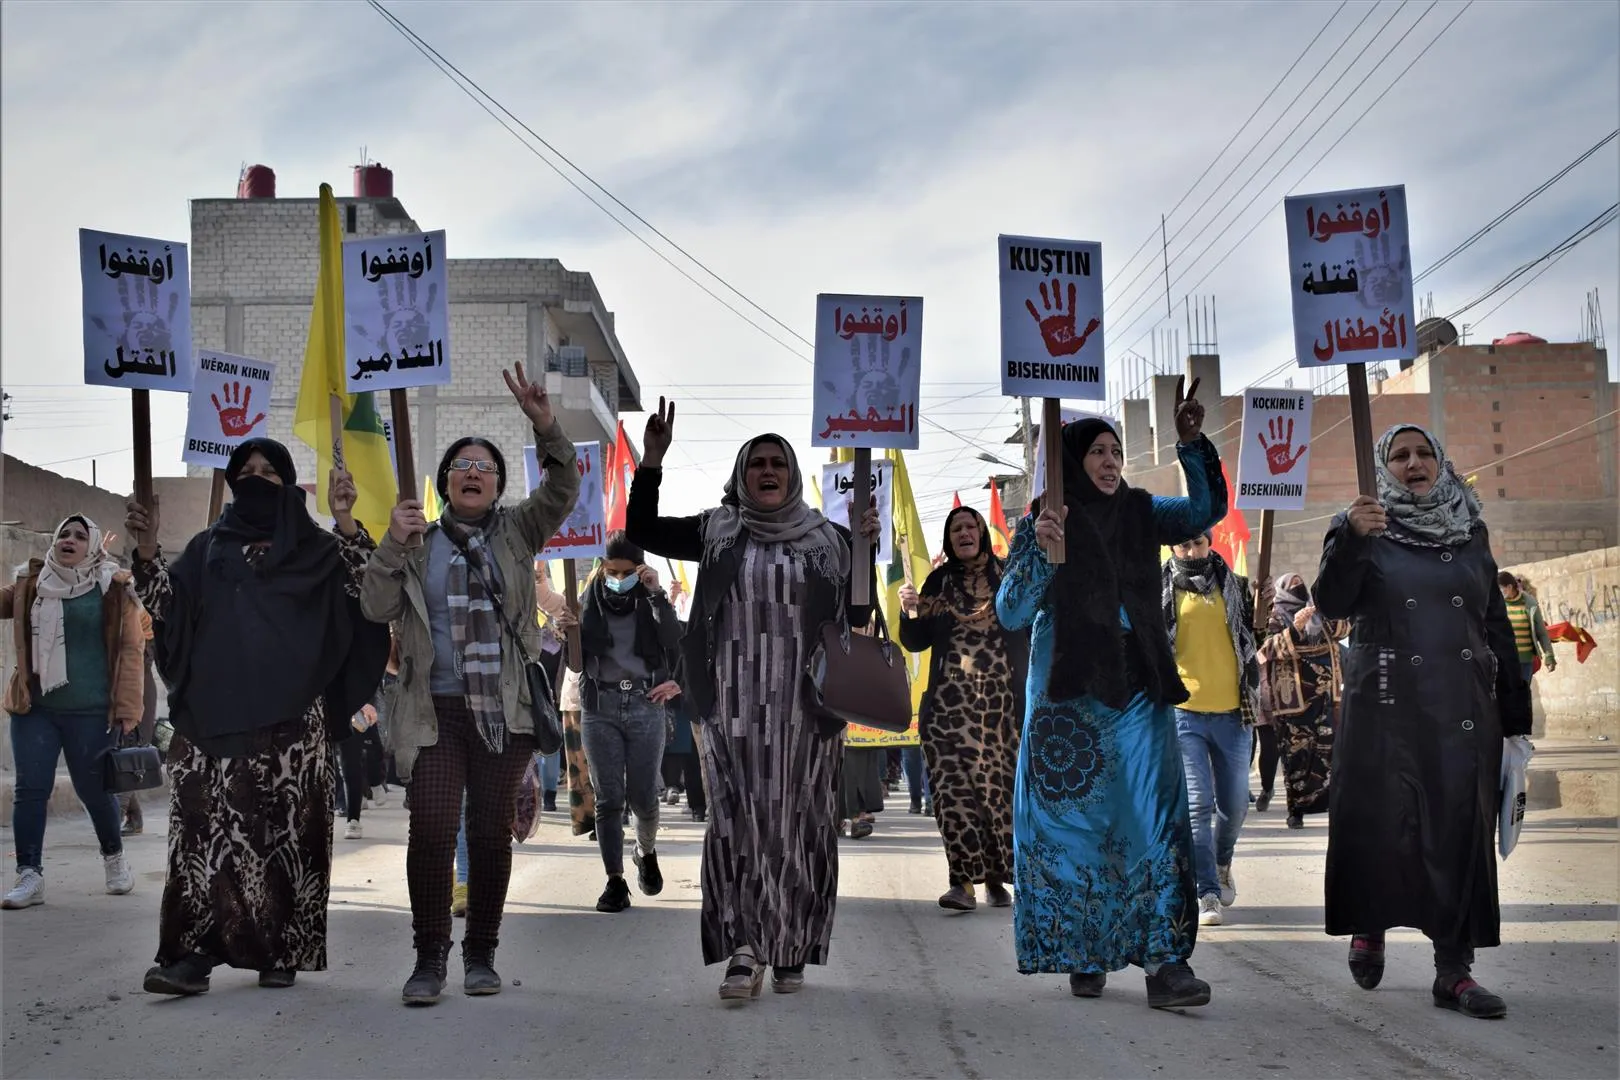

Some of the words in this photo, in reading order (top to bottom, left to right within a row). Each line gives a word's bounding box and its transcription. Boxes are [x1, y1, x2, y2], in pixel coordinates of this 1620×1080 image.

[1306, 190, 1391, 243] أوقفوا
[99, 243, 174, 285] أوقفوا
[361, 235, 433, 283] أوقفوا
[1009, 246, 1091, 277] KUŞTIN
[1302, 259, 1359, 295] قتلة
[834, 299, 908, 342] أوقفوا
[1313, 307, 1407, 362] الأطفال
[103, 345, 177, 379] القتل
[241, 365, 271, 382] KIRIN
[350, 338, 443, 381] التدمير
[818, 401, 914, 440] التهجير
[1252, 397, 1296, 411] KOÇKIRIN
